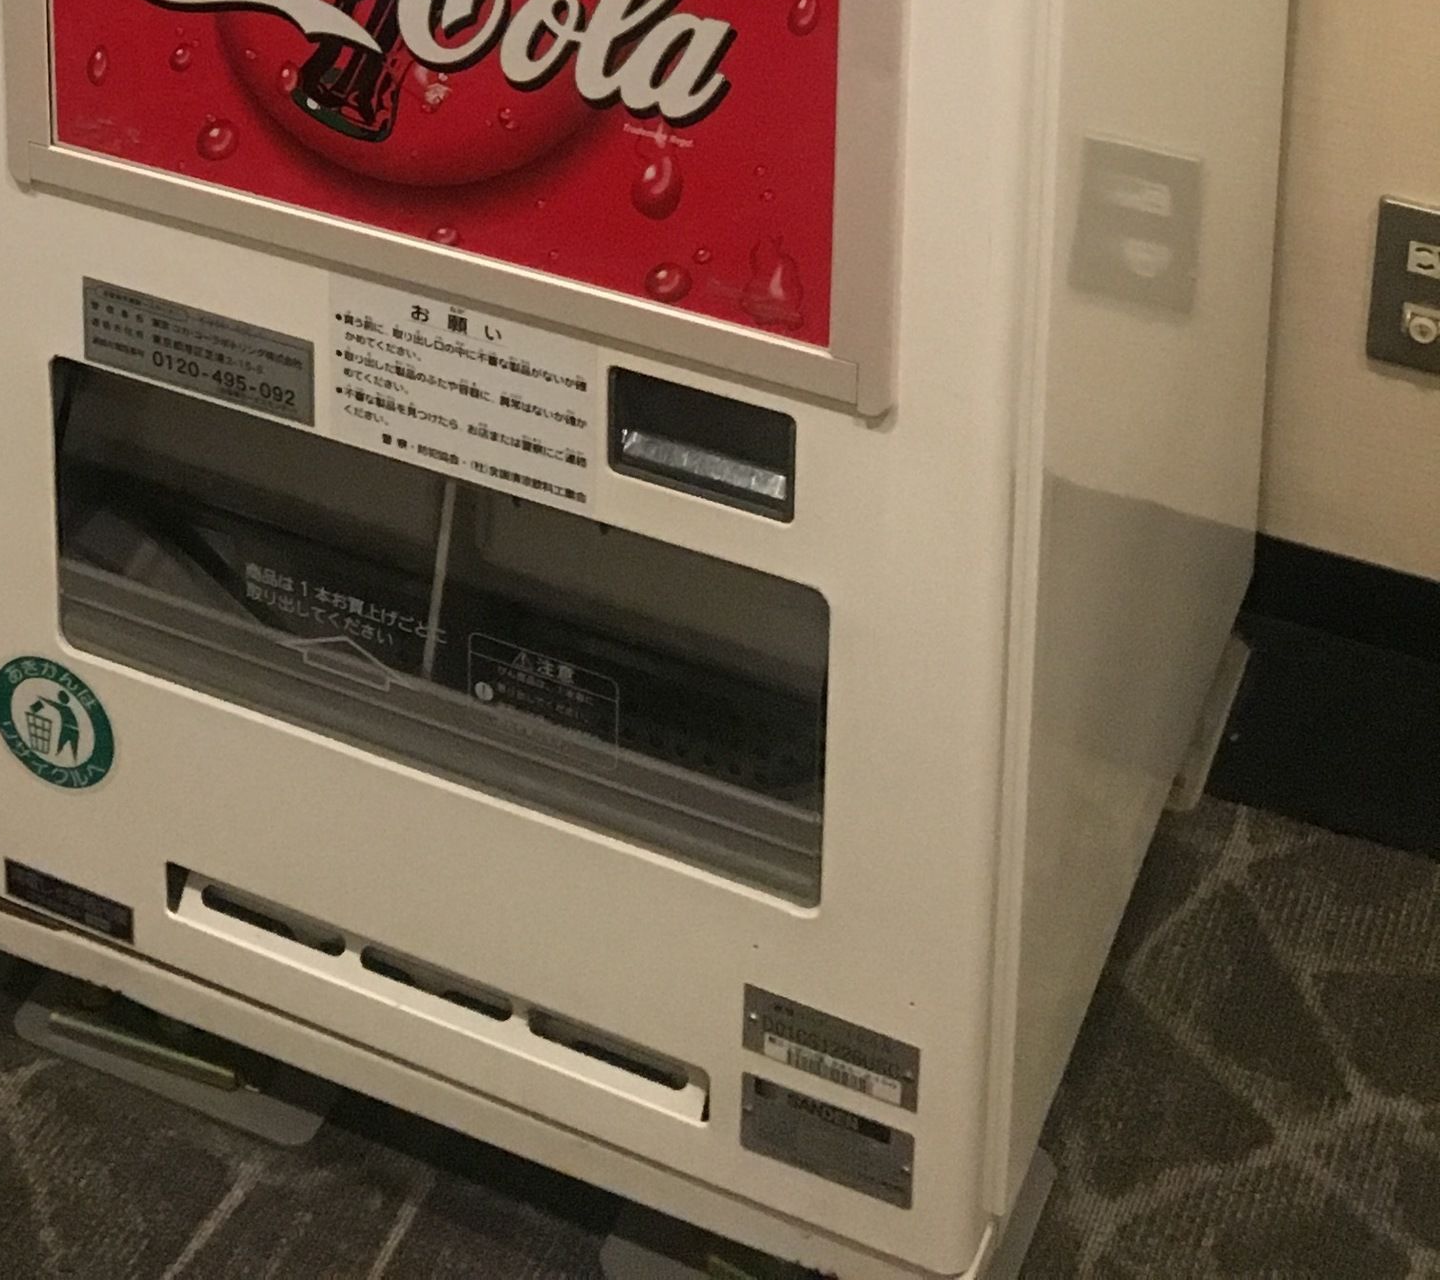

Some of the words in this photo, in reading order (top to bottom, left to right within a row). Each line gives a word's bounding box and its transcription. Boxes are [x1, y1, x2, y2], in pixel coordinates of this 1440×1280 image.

[410, 304, 502, 342] お願い
[151, 350, 297, 407] 0120-495-092
[245, 581, 394, 646] 取り出してください
[7, 662, 98, 710] あきかんは
[1, 719, 107, 788] リサイクルへ
